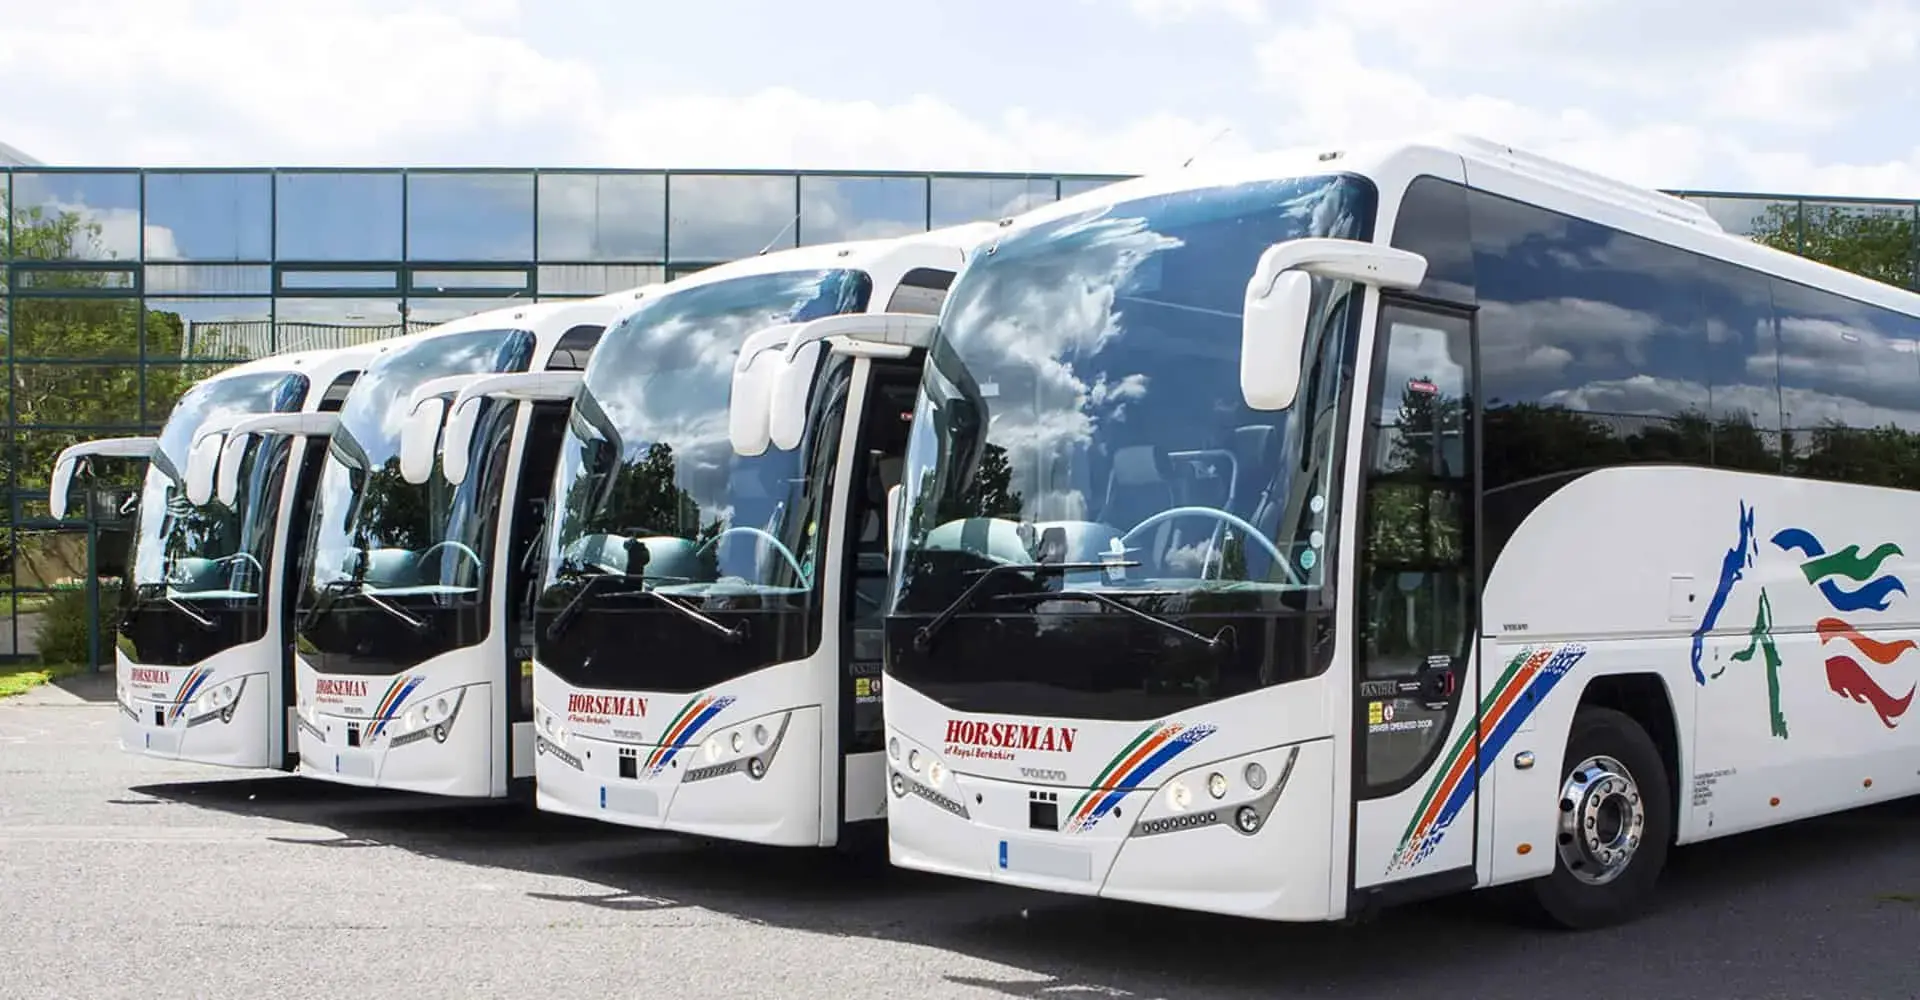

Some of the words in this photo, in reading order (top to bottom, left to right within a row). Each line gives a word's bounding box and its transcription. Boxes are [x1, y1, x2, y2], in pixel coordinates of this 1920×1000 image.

[316, 679, 369, 696] HORSEMAN
[568, 694, 648, 717] HORSEMAN
[944, 720, 1077, 752] HORSEMAN
[952, 746, 974, 759] Royal
[1020, 767, 1067, 781] VOLVO
